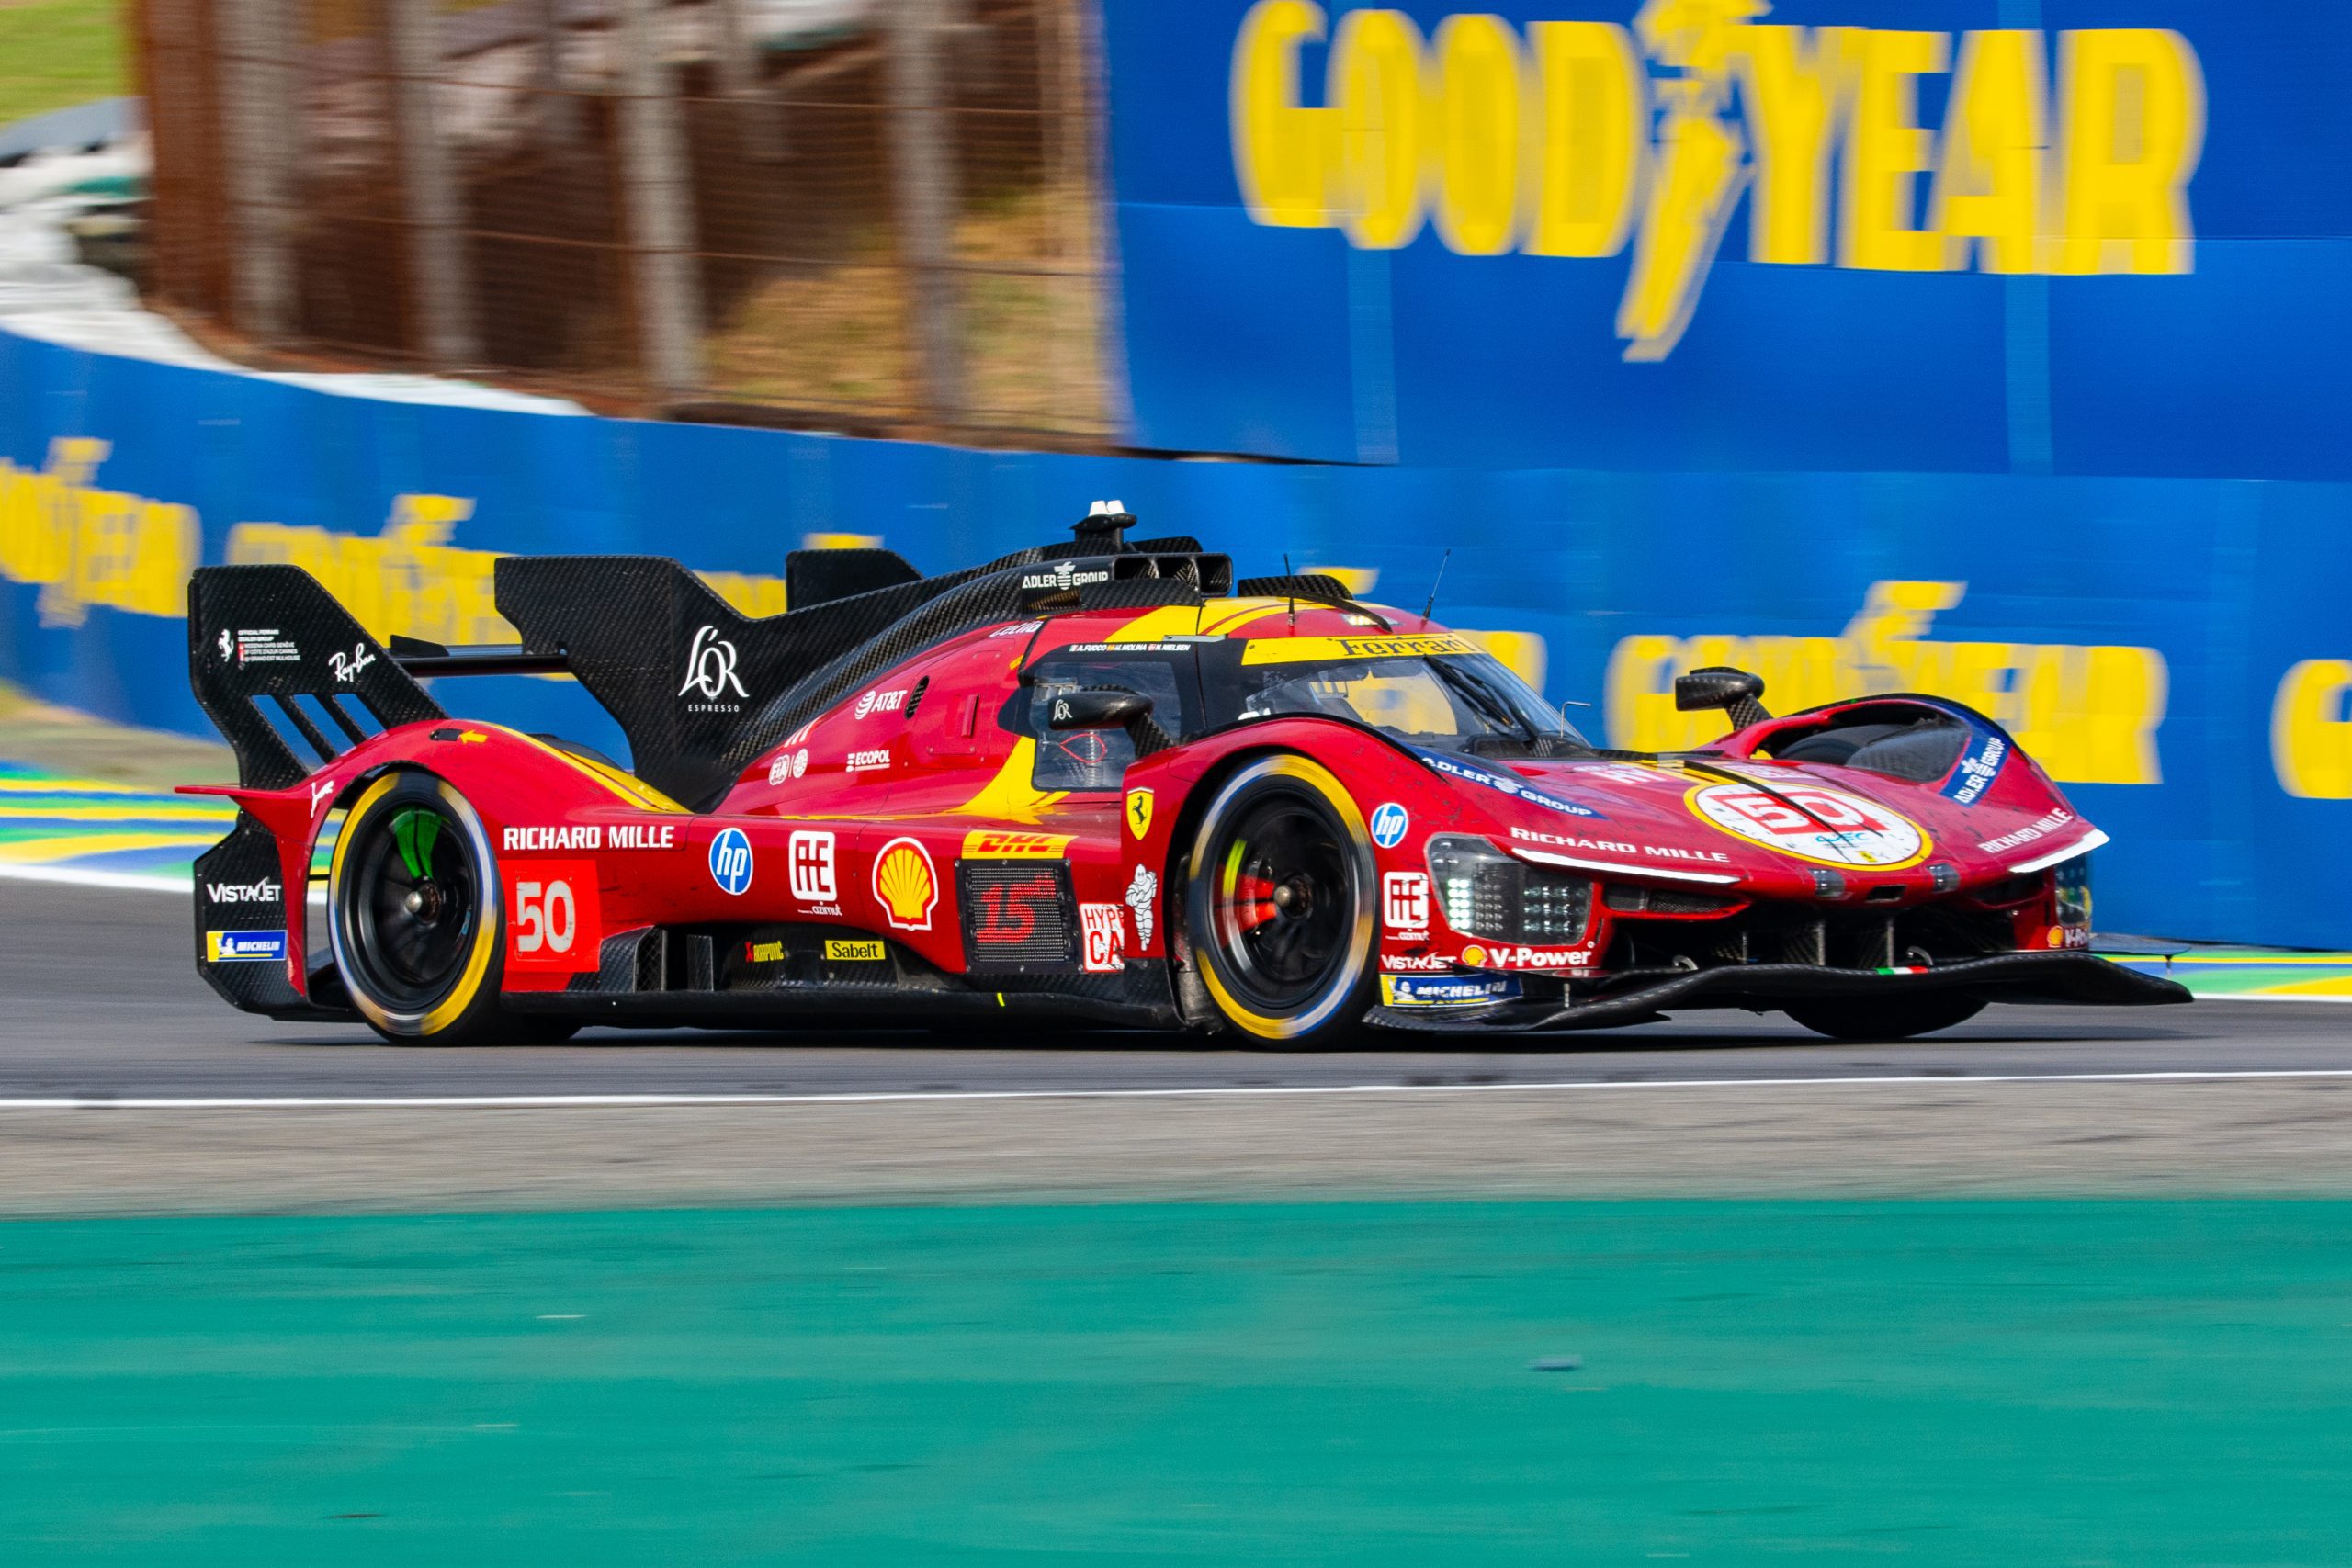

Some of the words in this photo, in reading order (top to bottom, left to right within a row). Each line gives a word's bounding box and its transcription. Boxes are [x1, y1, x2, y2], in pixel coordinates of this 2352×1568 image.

[1229, 0, 2207, 276] GOODYEAR
[1022, 575, 1057, 589] ADLER
[1071, 570, 1109, 586] GROUP
[687, 704, 740, 712] ESPRESSO
[870, 690, 908, 712] AT&T
[854, 750, 890, 766] ECOPOL
[1980, 736, 2006, 767] GROUP
[1521, 791, 1592, 817] GROUP
[503, 826, 601, 851] RICHARD
[608, 826, 675, 849] MILLE
[1977, 827, 2043, 854] RICHARD
[2031, 807, 2074, 834] MILLE
[977, 834, 1057, 853] DHL
[1510, 827, 1637, 854] RICHARD
[1643, 845, 1730, 863] MILLE
[715, 828, 750, 895] hp
[515, 879, 576, 953] 50
[235, 940, 280, 952] MICHELIN
[831, 942, 878, 959] Sabelt
[1489, 947, 1592, 968] V-Power
[1415, 980, 1508, 998] MICHELIN
